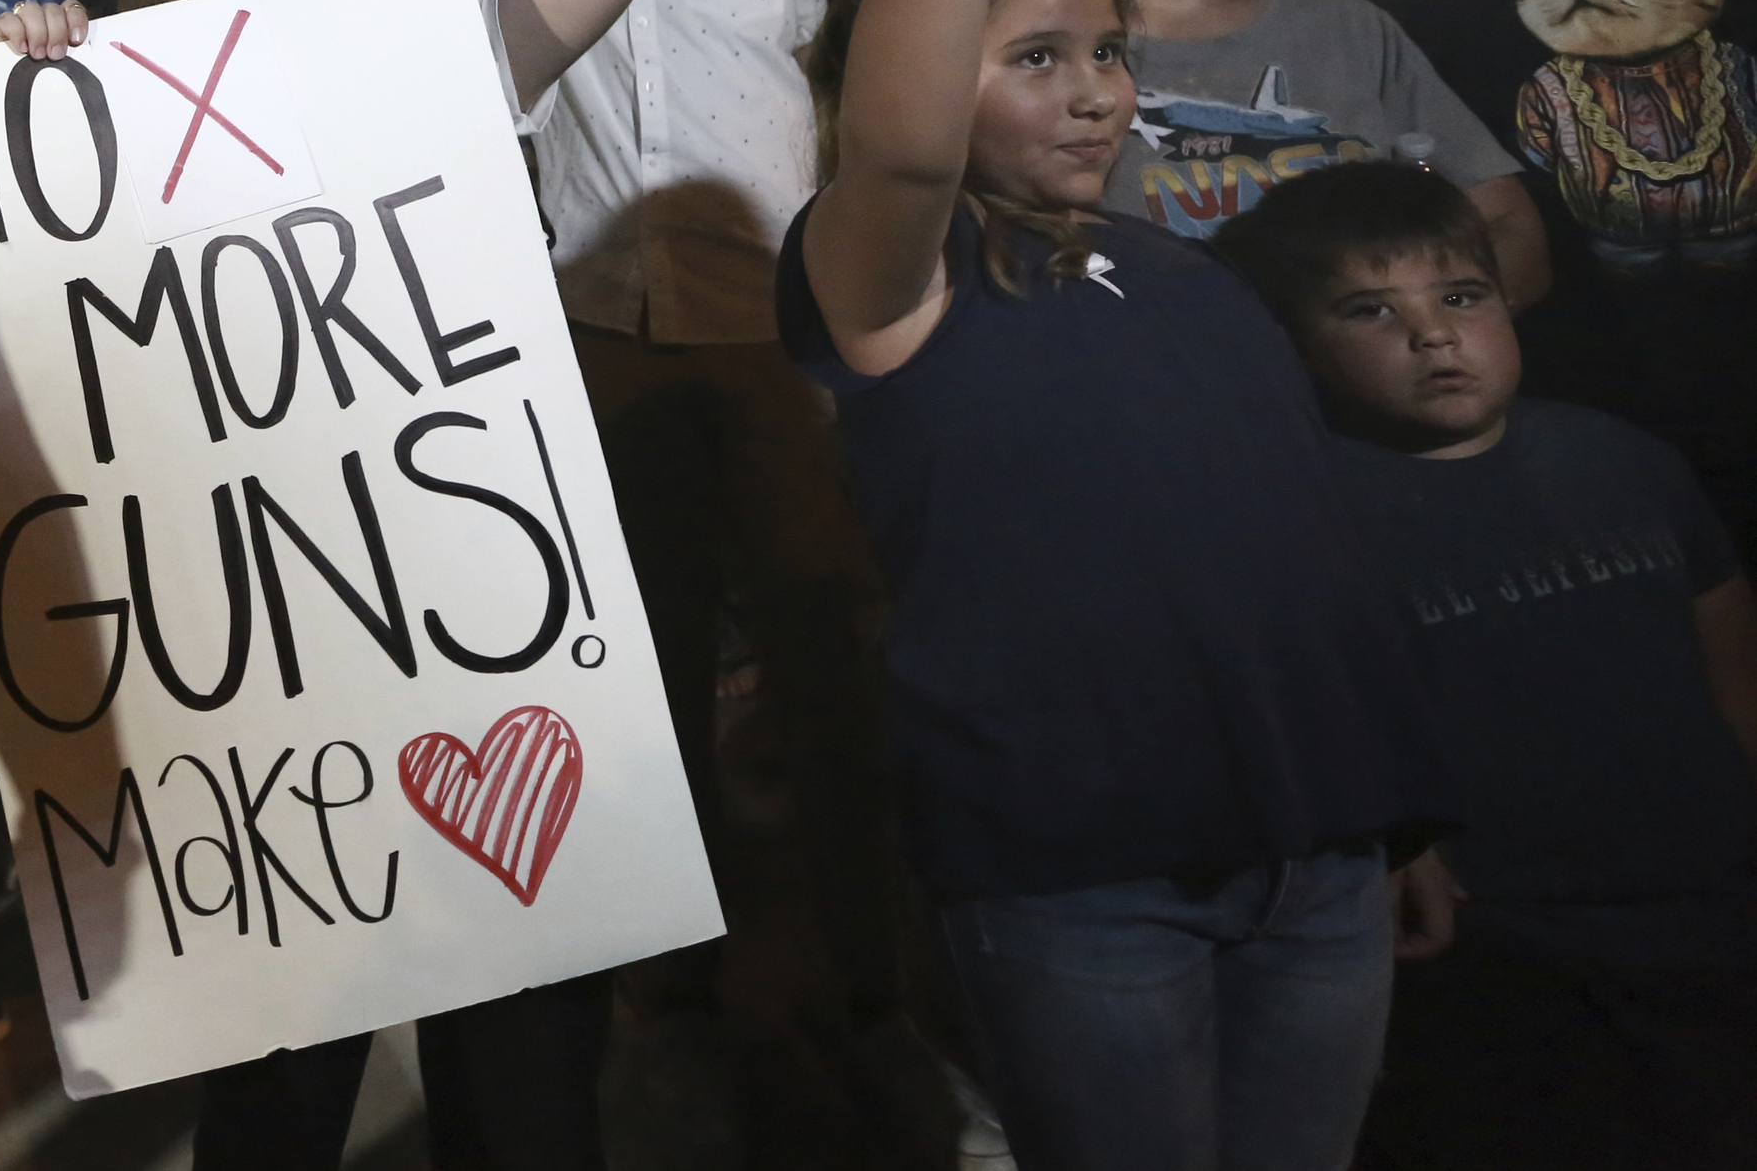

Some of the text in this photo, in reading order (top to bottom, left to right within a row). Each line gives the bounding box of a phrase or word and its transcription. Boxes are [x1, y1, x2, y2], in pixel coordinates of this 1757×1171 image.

[1180, 134, 1233, 158] 1981
[1139, 139, 1370, 226] NAS
[66, 175, 520, 463] MORE
[1400, 573, 1477, 625] EL
